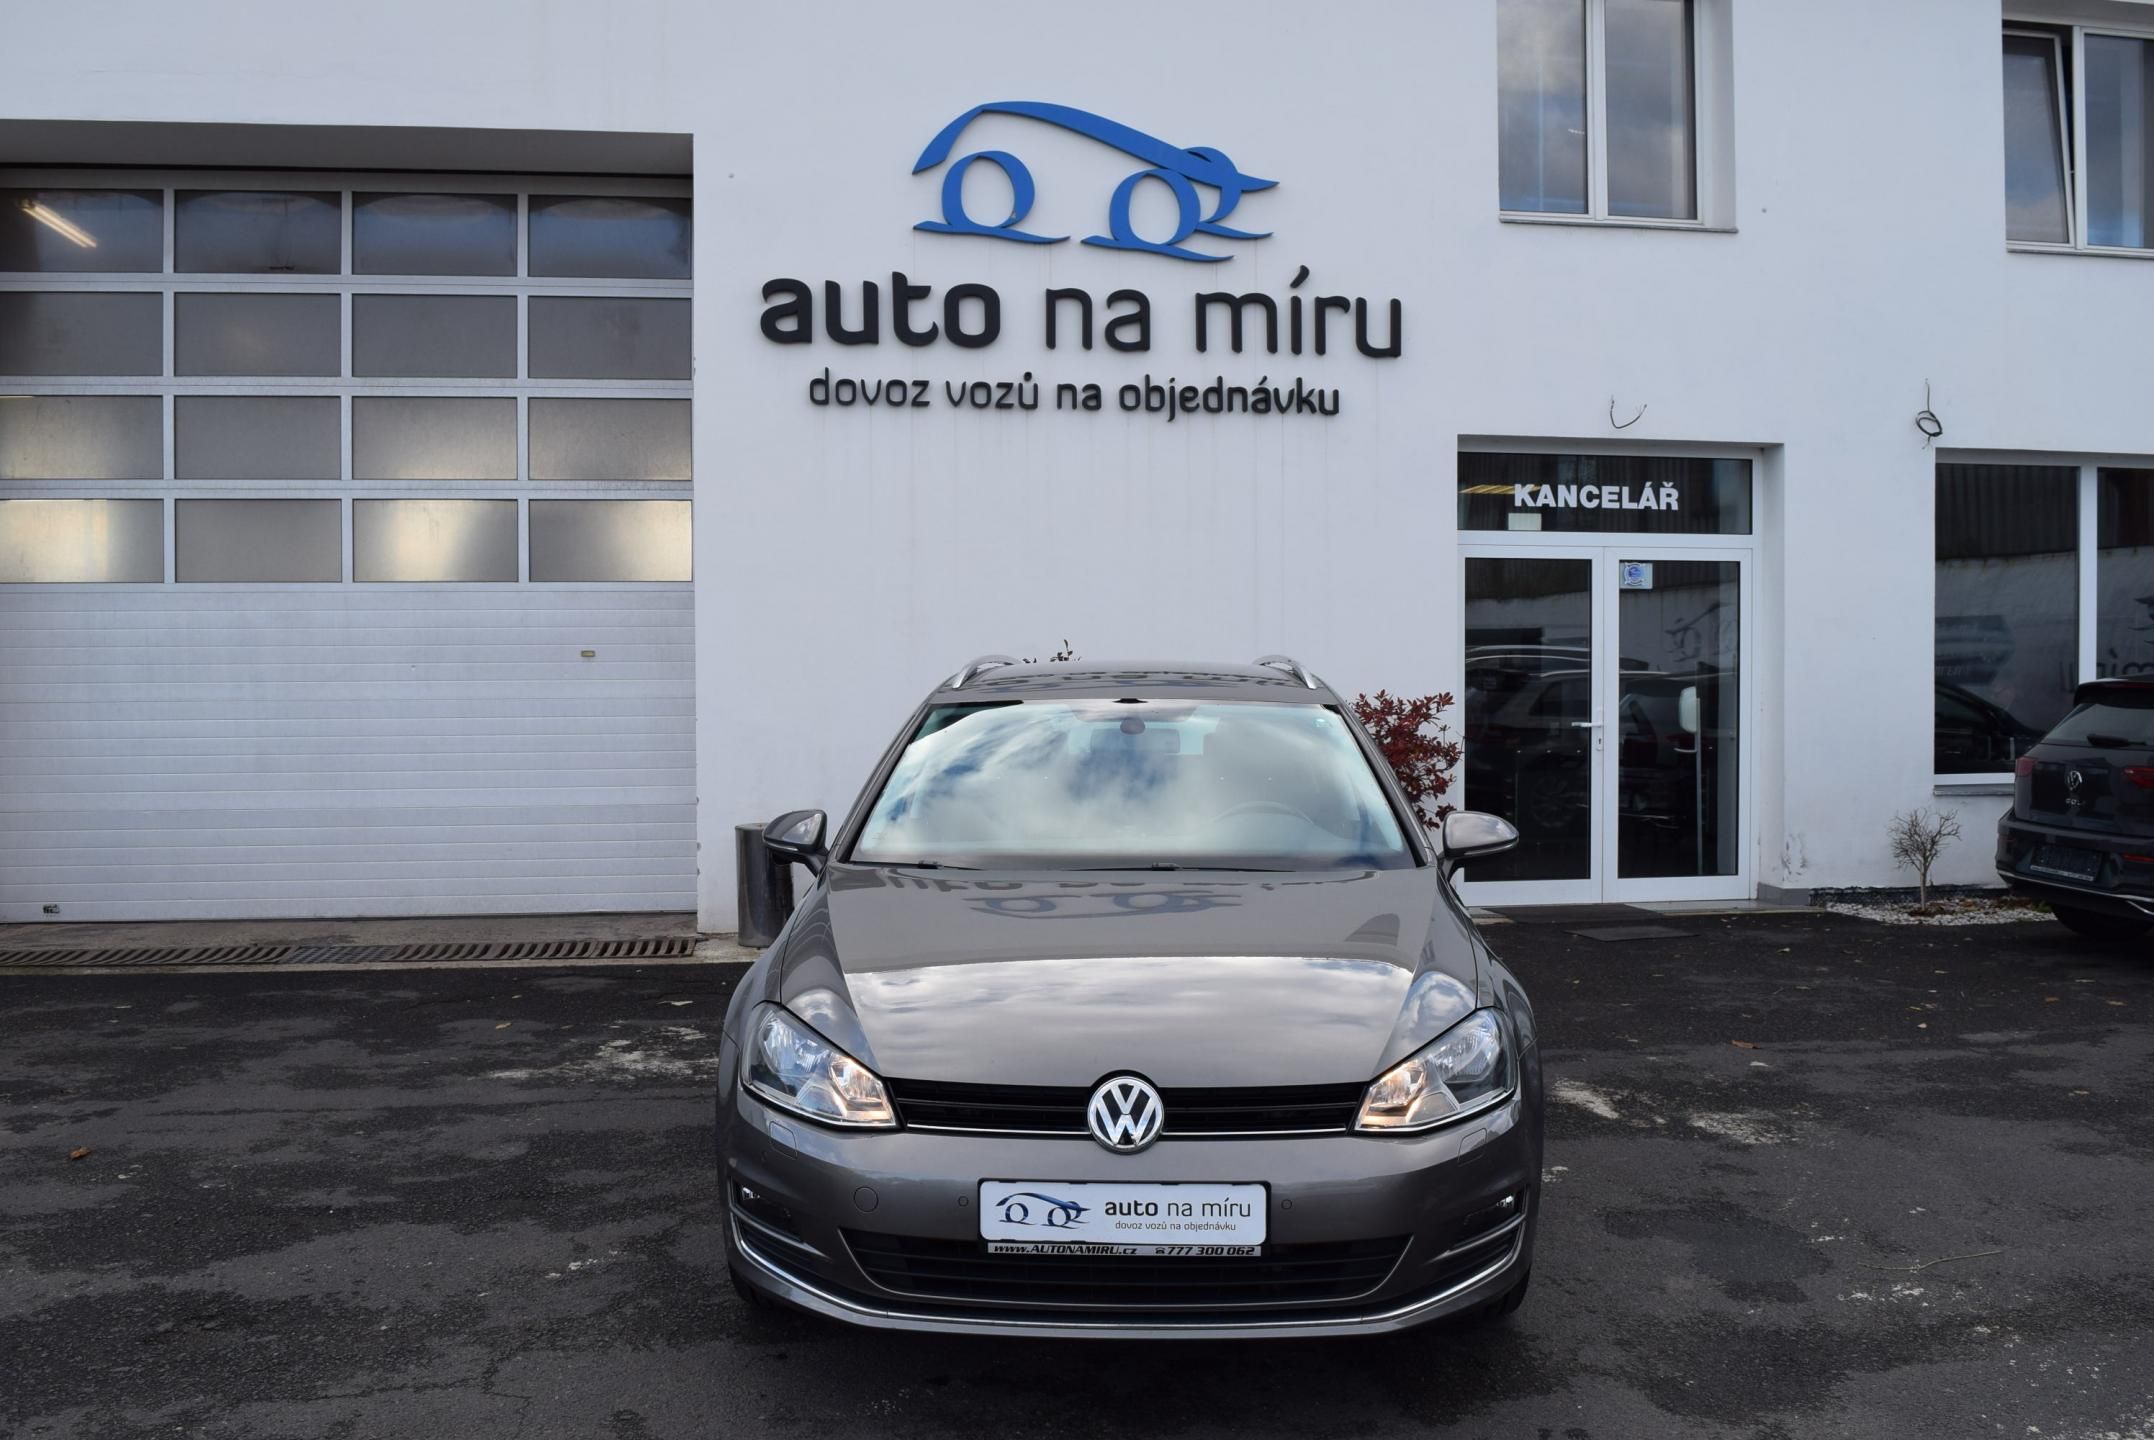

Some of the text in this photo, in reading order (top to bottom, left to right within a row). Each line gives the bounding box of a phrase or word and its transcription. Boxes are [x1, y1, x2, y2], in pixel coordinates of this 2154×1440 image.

[760, 264, 1402, 359] auto na míru
[809, 366, 1340, 422] dovoz vozů na objednávku
[1514, 481, 1679, 511] KANCELÁŘ
[1104, 1197, 1251, 1218] auto na míru
[1115, 1220, 1237, 1232] dovoz vozů na objednávku
[993, 1244, 1255, 1256] www.AUTONAMIRU.cz 777 300 062
